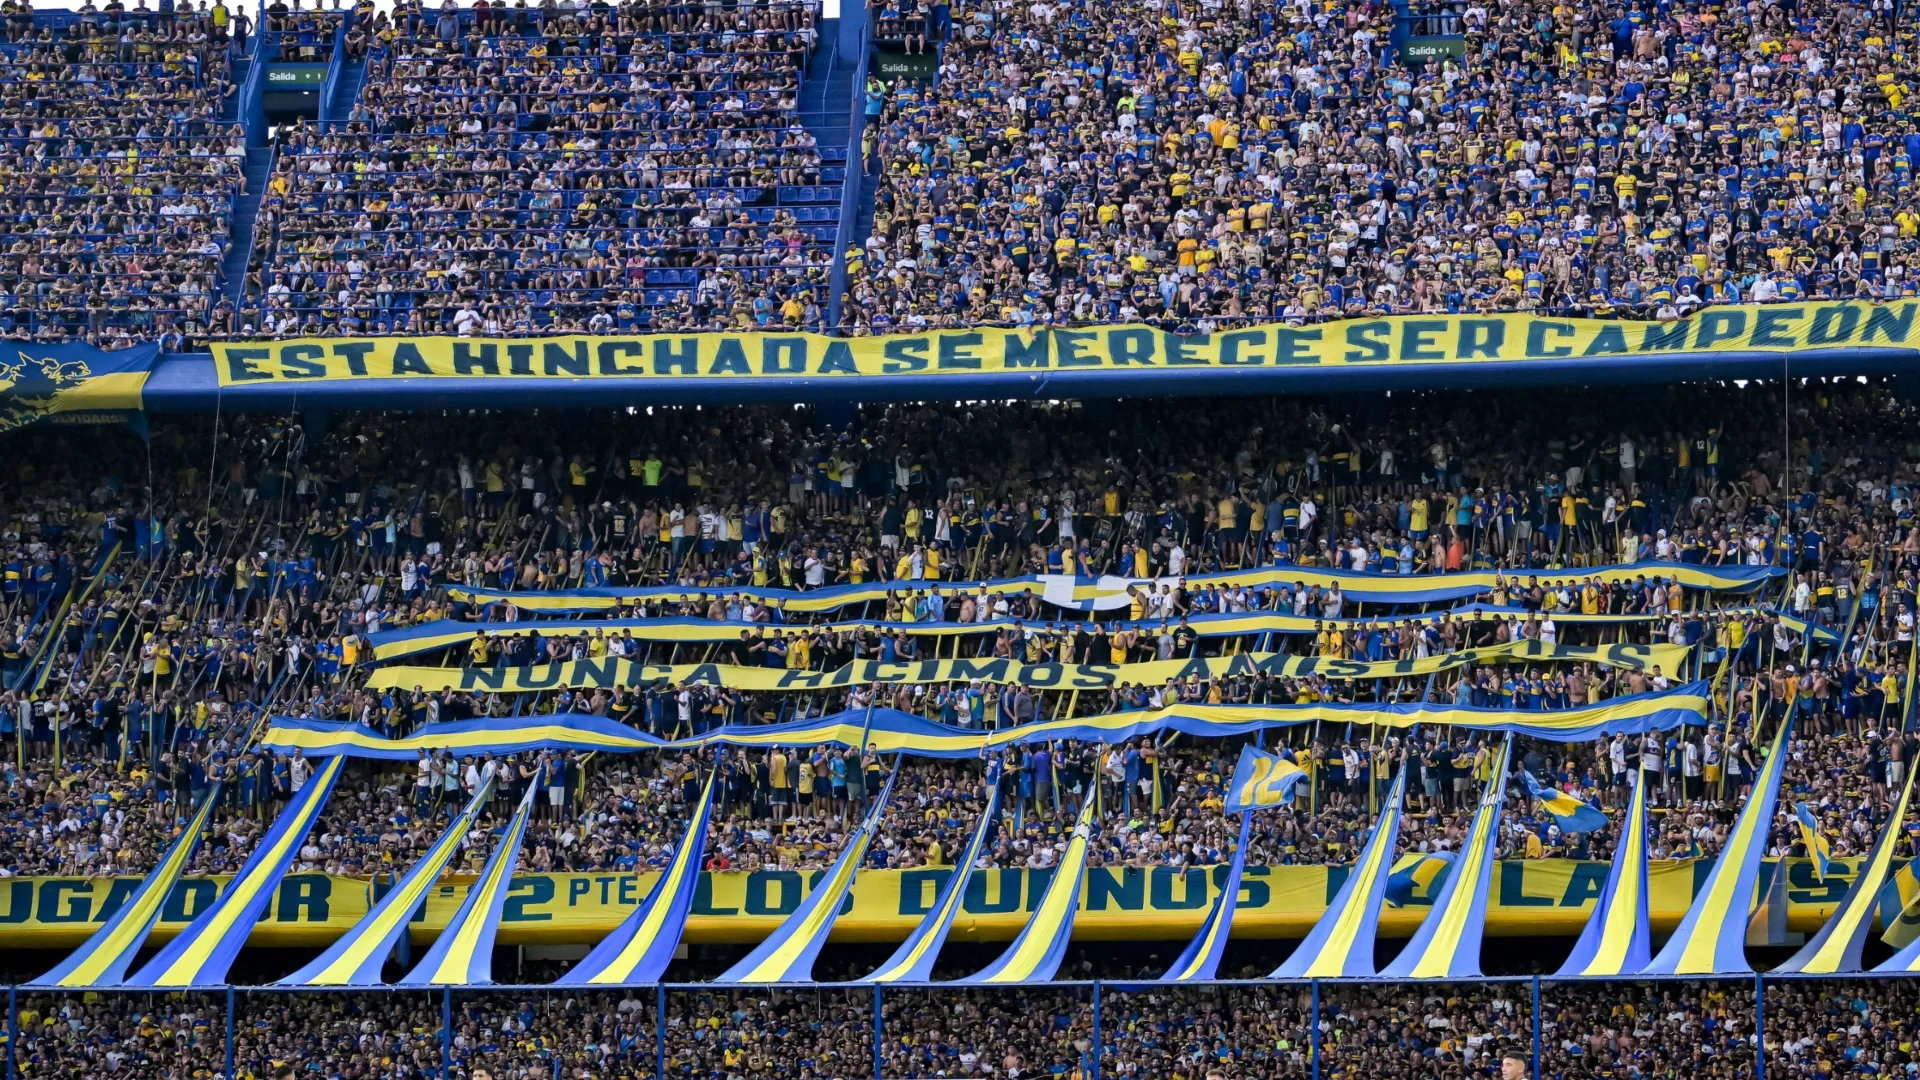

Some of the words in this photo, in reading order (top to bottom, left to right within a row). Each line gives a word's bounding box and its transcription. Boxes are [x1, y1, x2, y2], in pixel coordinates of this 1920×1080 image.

[1408, 47, 1437, 56] Salida
[881, 63, 909, 72] Salida
[269, 72, 296, 81] Salida
[225, 342, 434, 381] ESTA
[453, 338, 860, 375] HINCHADA
[883, 333, 983, 373] SE
[1004, 328, 1323, 367] MERECE
[1344, 320, 1501, 361] SER
[1525, 301, 1918, 357] CAMPEÓN
[925, 508, 934, 519] 12
[1837, 589, 1847, 599] 12
[460, 656, 721, 689] NUNCA
[777, 658, 1121, 687] HICIMOS
[0, 873, 332, 923] UGADR
[898, 864, 1271, 915] DUNOS
[1499, 860, 1614, 906] LA
